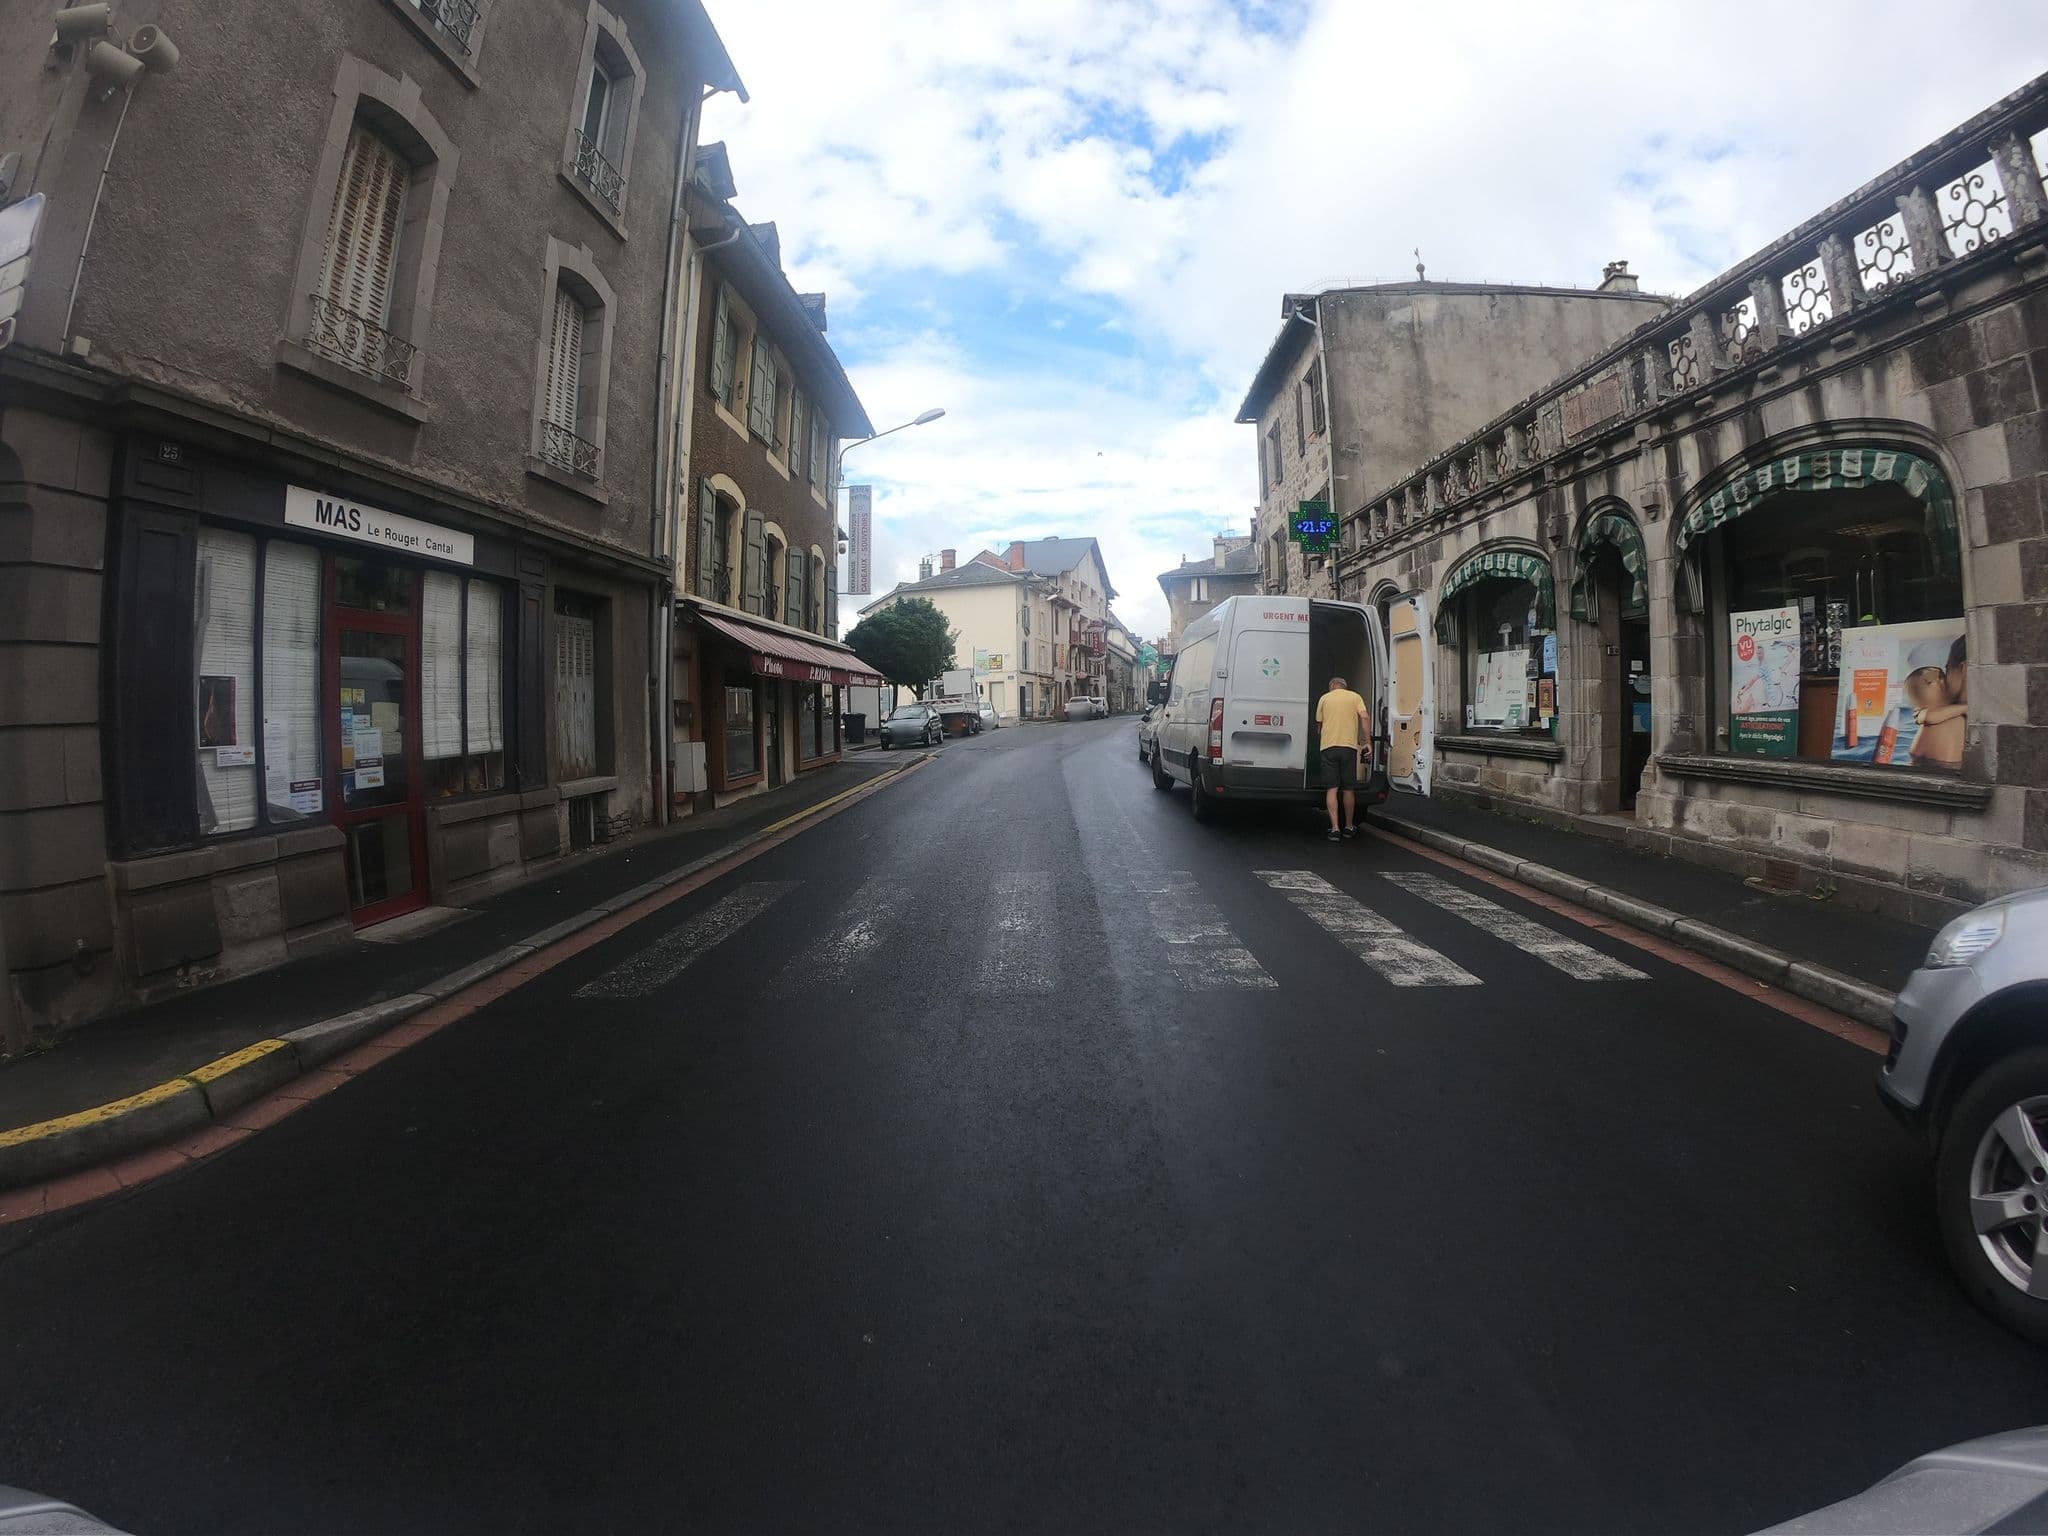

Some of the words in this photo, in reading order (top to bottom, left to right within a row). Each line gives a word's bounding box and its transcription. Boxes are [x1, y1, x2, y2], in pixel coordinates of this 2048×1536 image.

[162, 446, 178, 460] 25
[315, 499, 361, 532] MAS
[367, 523, 380, 537] Le
[384, 527, 419, 546] Rouget
[425, 538, 453, 555] Cantal
[861, 512, 869, 552] SOUVENIRS
[860, 558, 868, 592] CADEAUX
[1263, 611, 1294, 621] URGENT
[1736, 614, 1792, 637] Phytalgic
[764, 656, 784, 675] Photo
